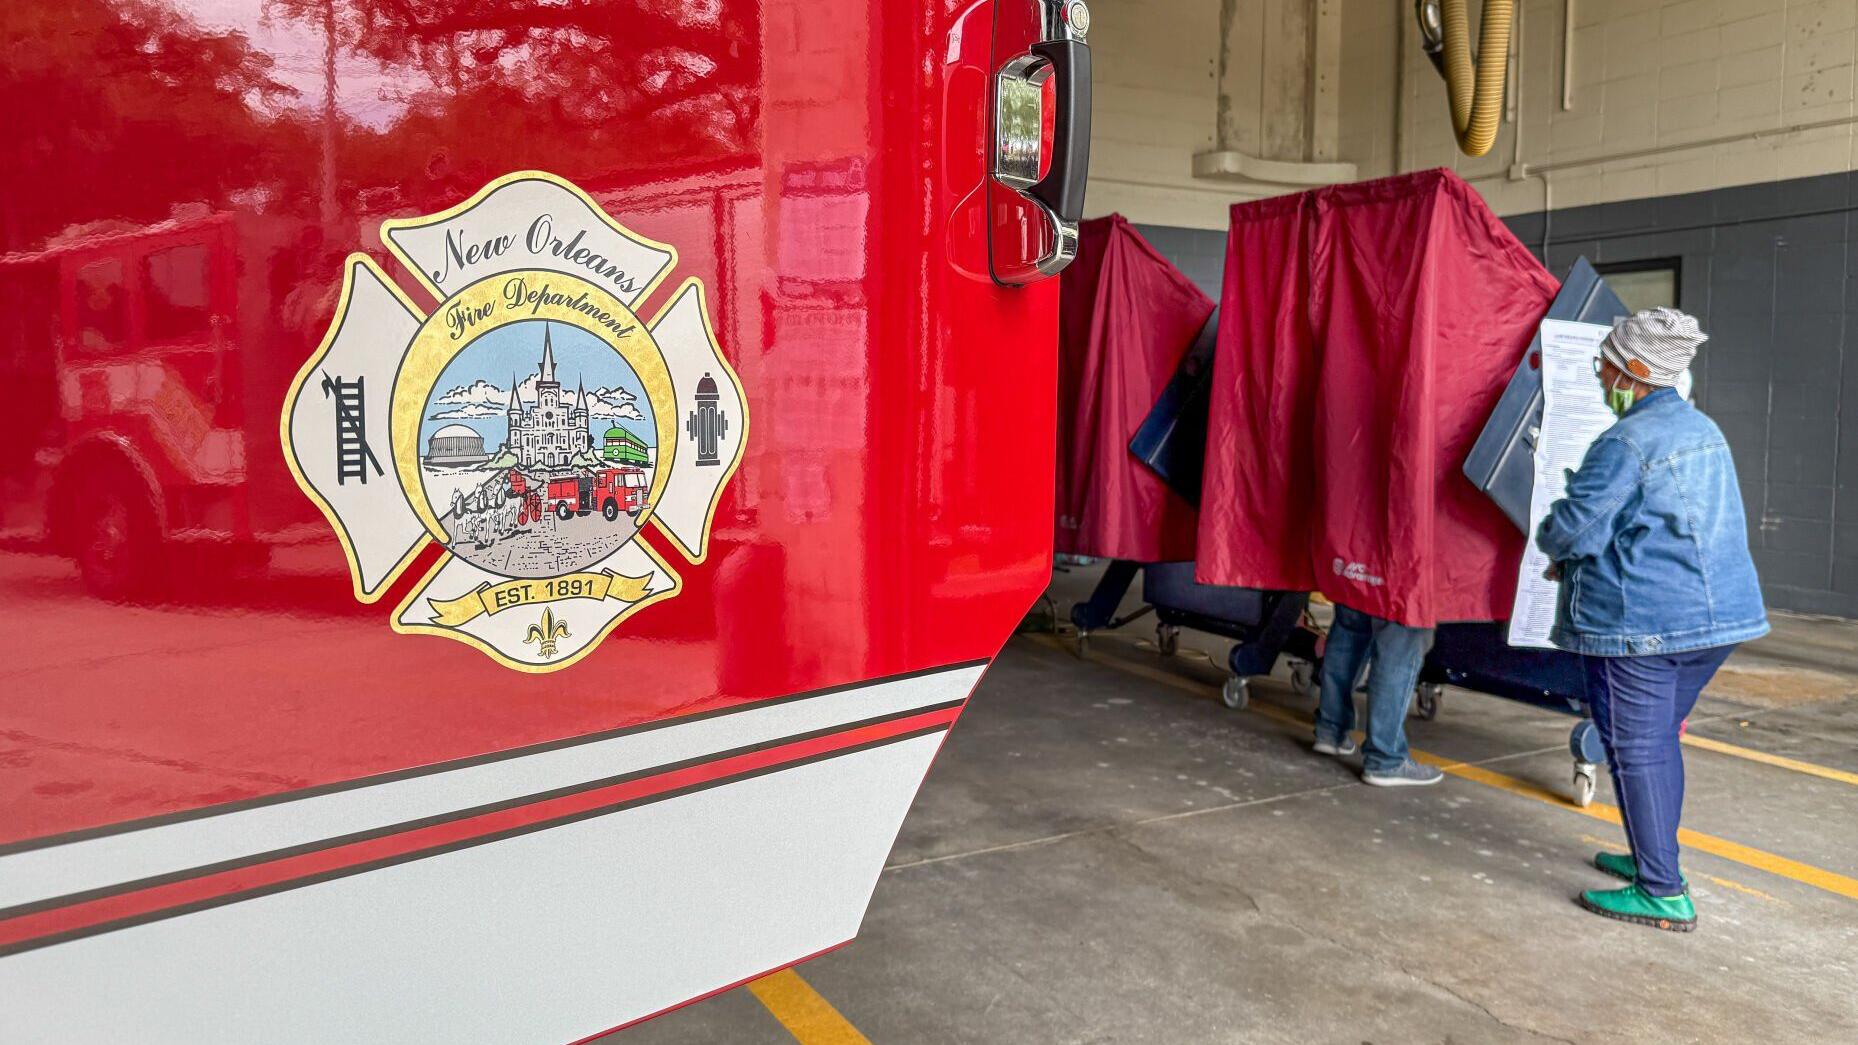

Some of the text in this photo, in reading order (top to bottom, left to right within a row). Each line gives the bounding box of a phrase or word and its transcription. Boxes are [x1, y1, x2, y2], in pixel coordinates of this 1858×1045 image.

[433, 213, 642, 293] New Orleans
[446, 277, 637, 341] Fire Department
[495, 579, 593, 608] EST. 1891
